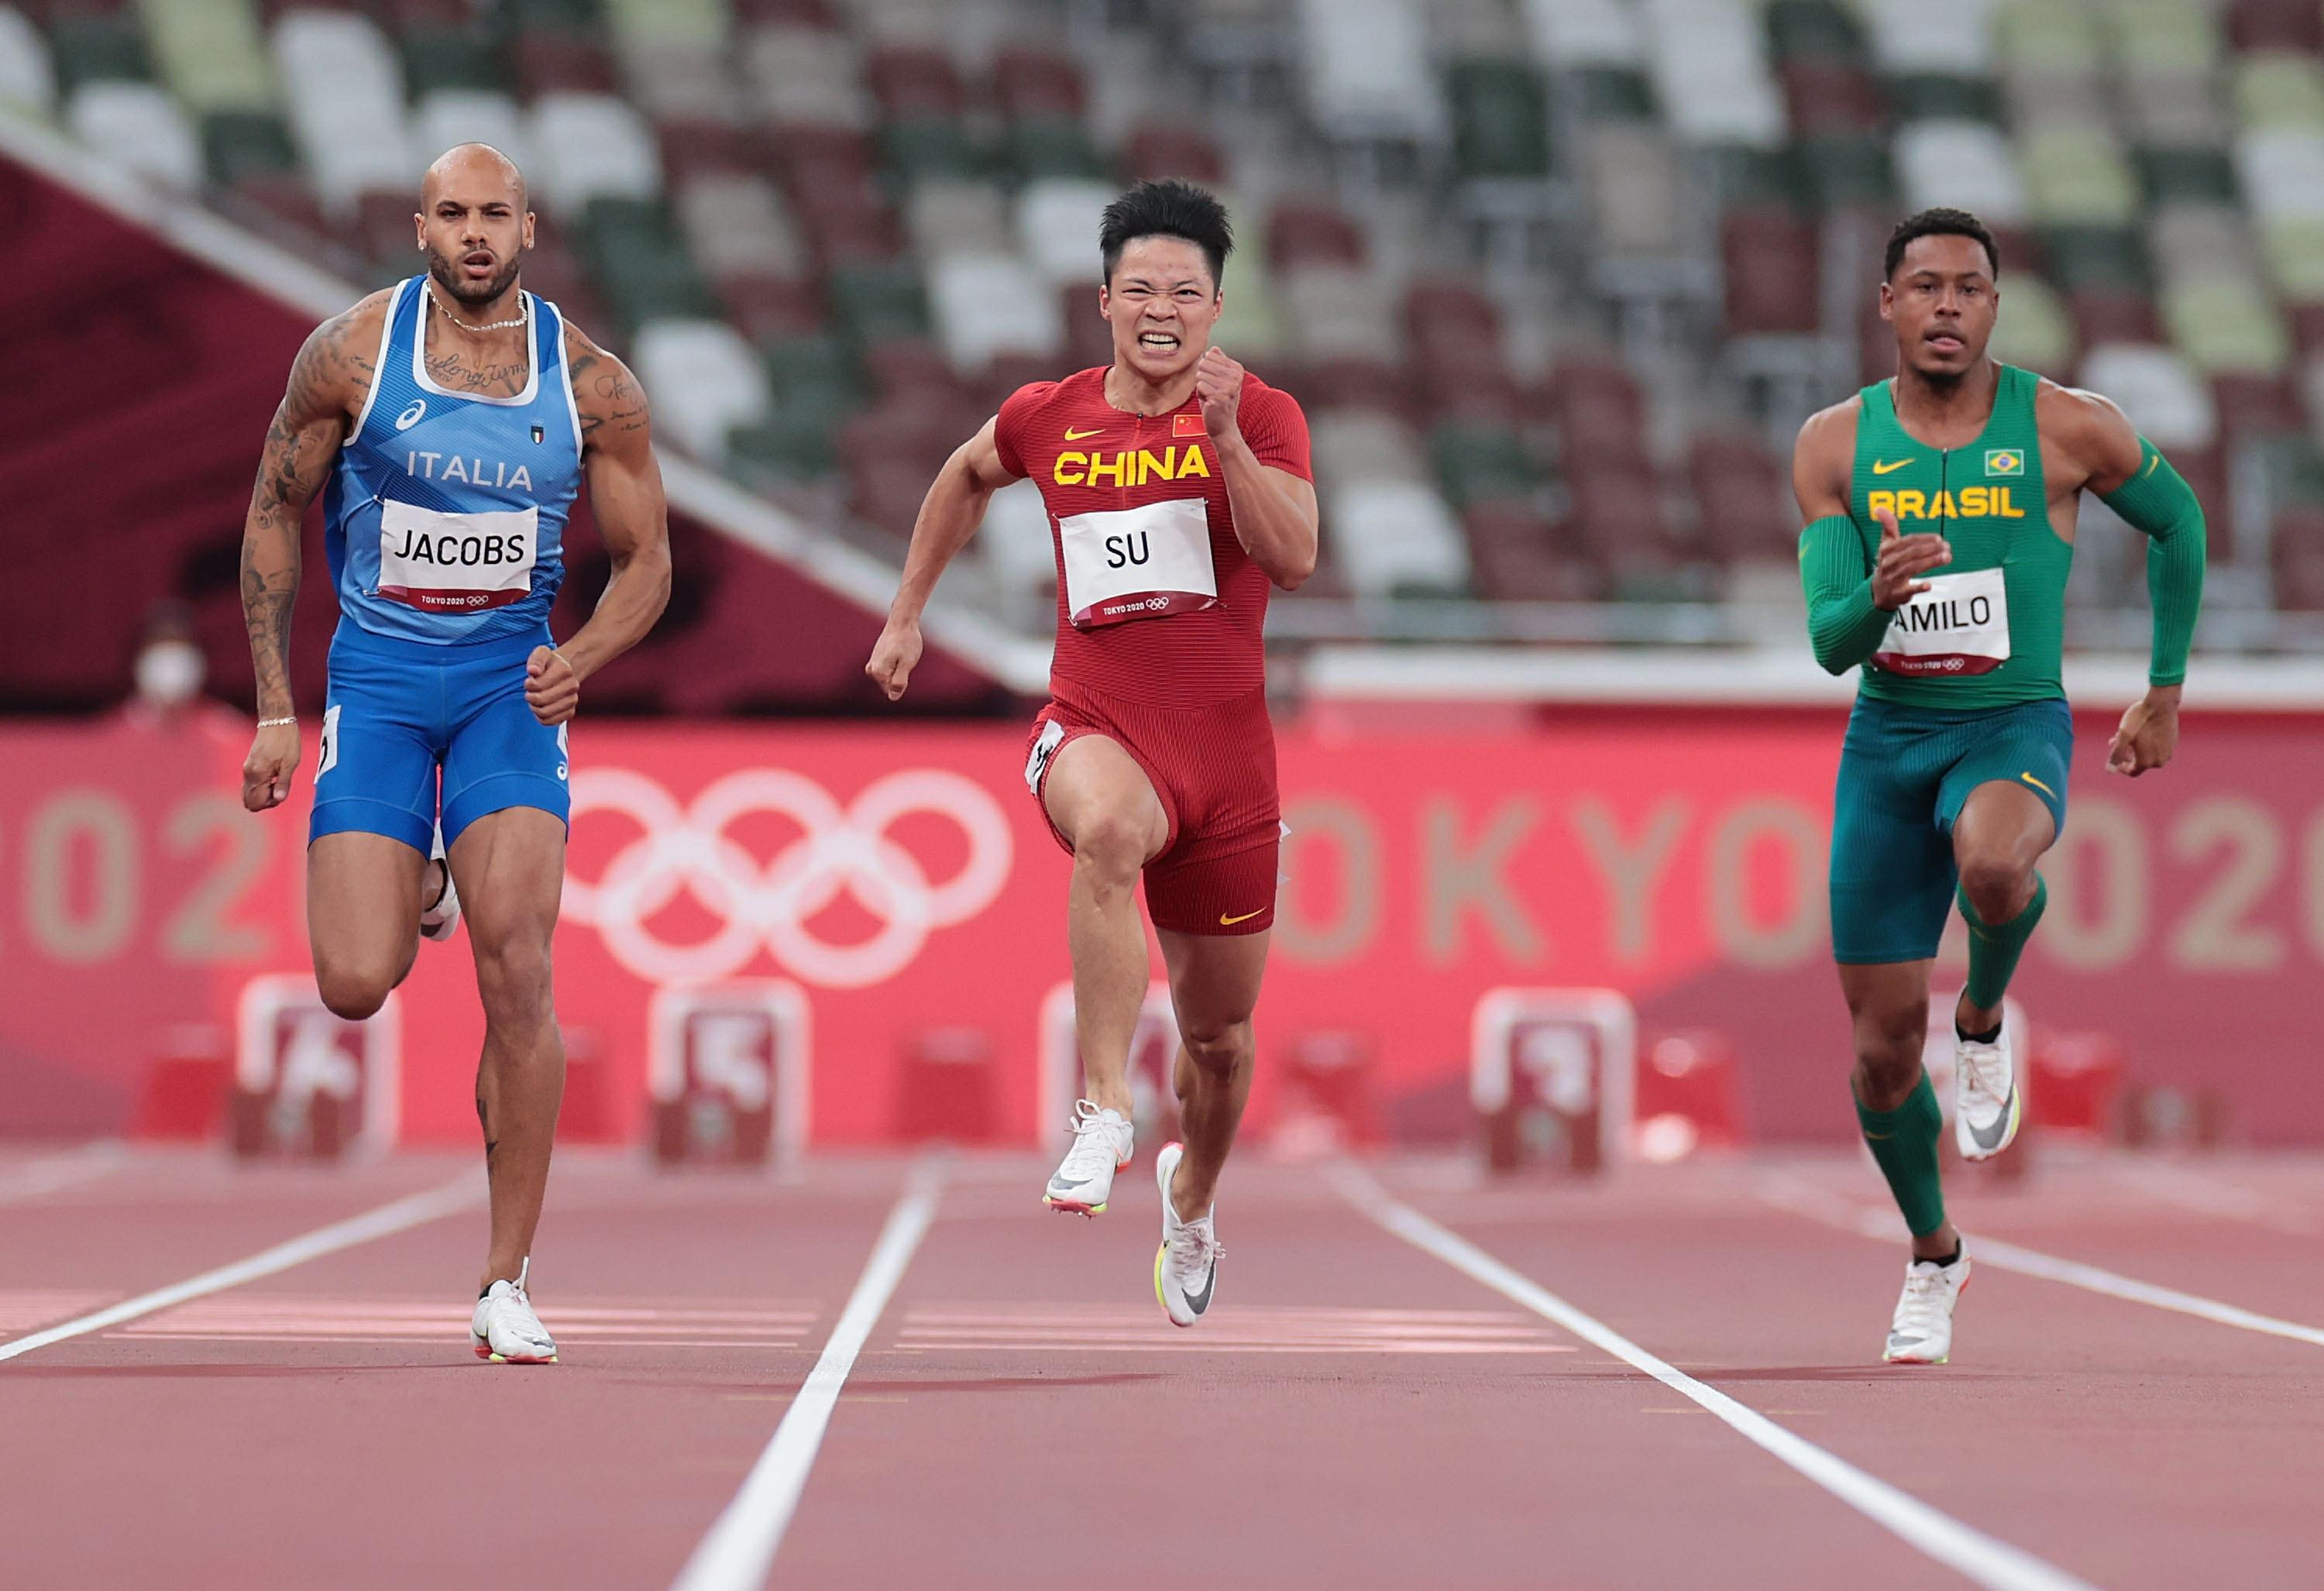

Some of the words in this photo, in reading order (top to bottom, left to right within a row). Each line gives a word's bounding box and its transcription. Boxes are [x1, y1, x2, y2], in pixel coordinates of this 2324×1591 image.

[407, 451, 533, 491] ITALIA
[1054, 445, 1210, 487] CHINA
[1868, 486, 2025, 521] BRASIL
[394, 530, 525, 565] JACOBS
[1105, 531, 1150, 569] SU
[421, 595, 445, 604] TOKYO
[1103, 605, 1126, 615] TOKYO
[1126, 602, 1145, 612] 2020
[1894, 596, 1990, 632] AMILO
[0, 789, 310, 964] 02
[1274, 794, 1830, 967] OKYO
